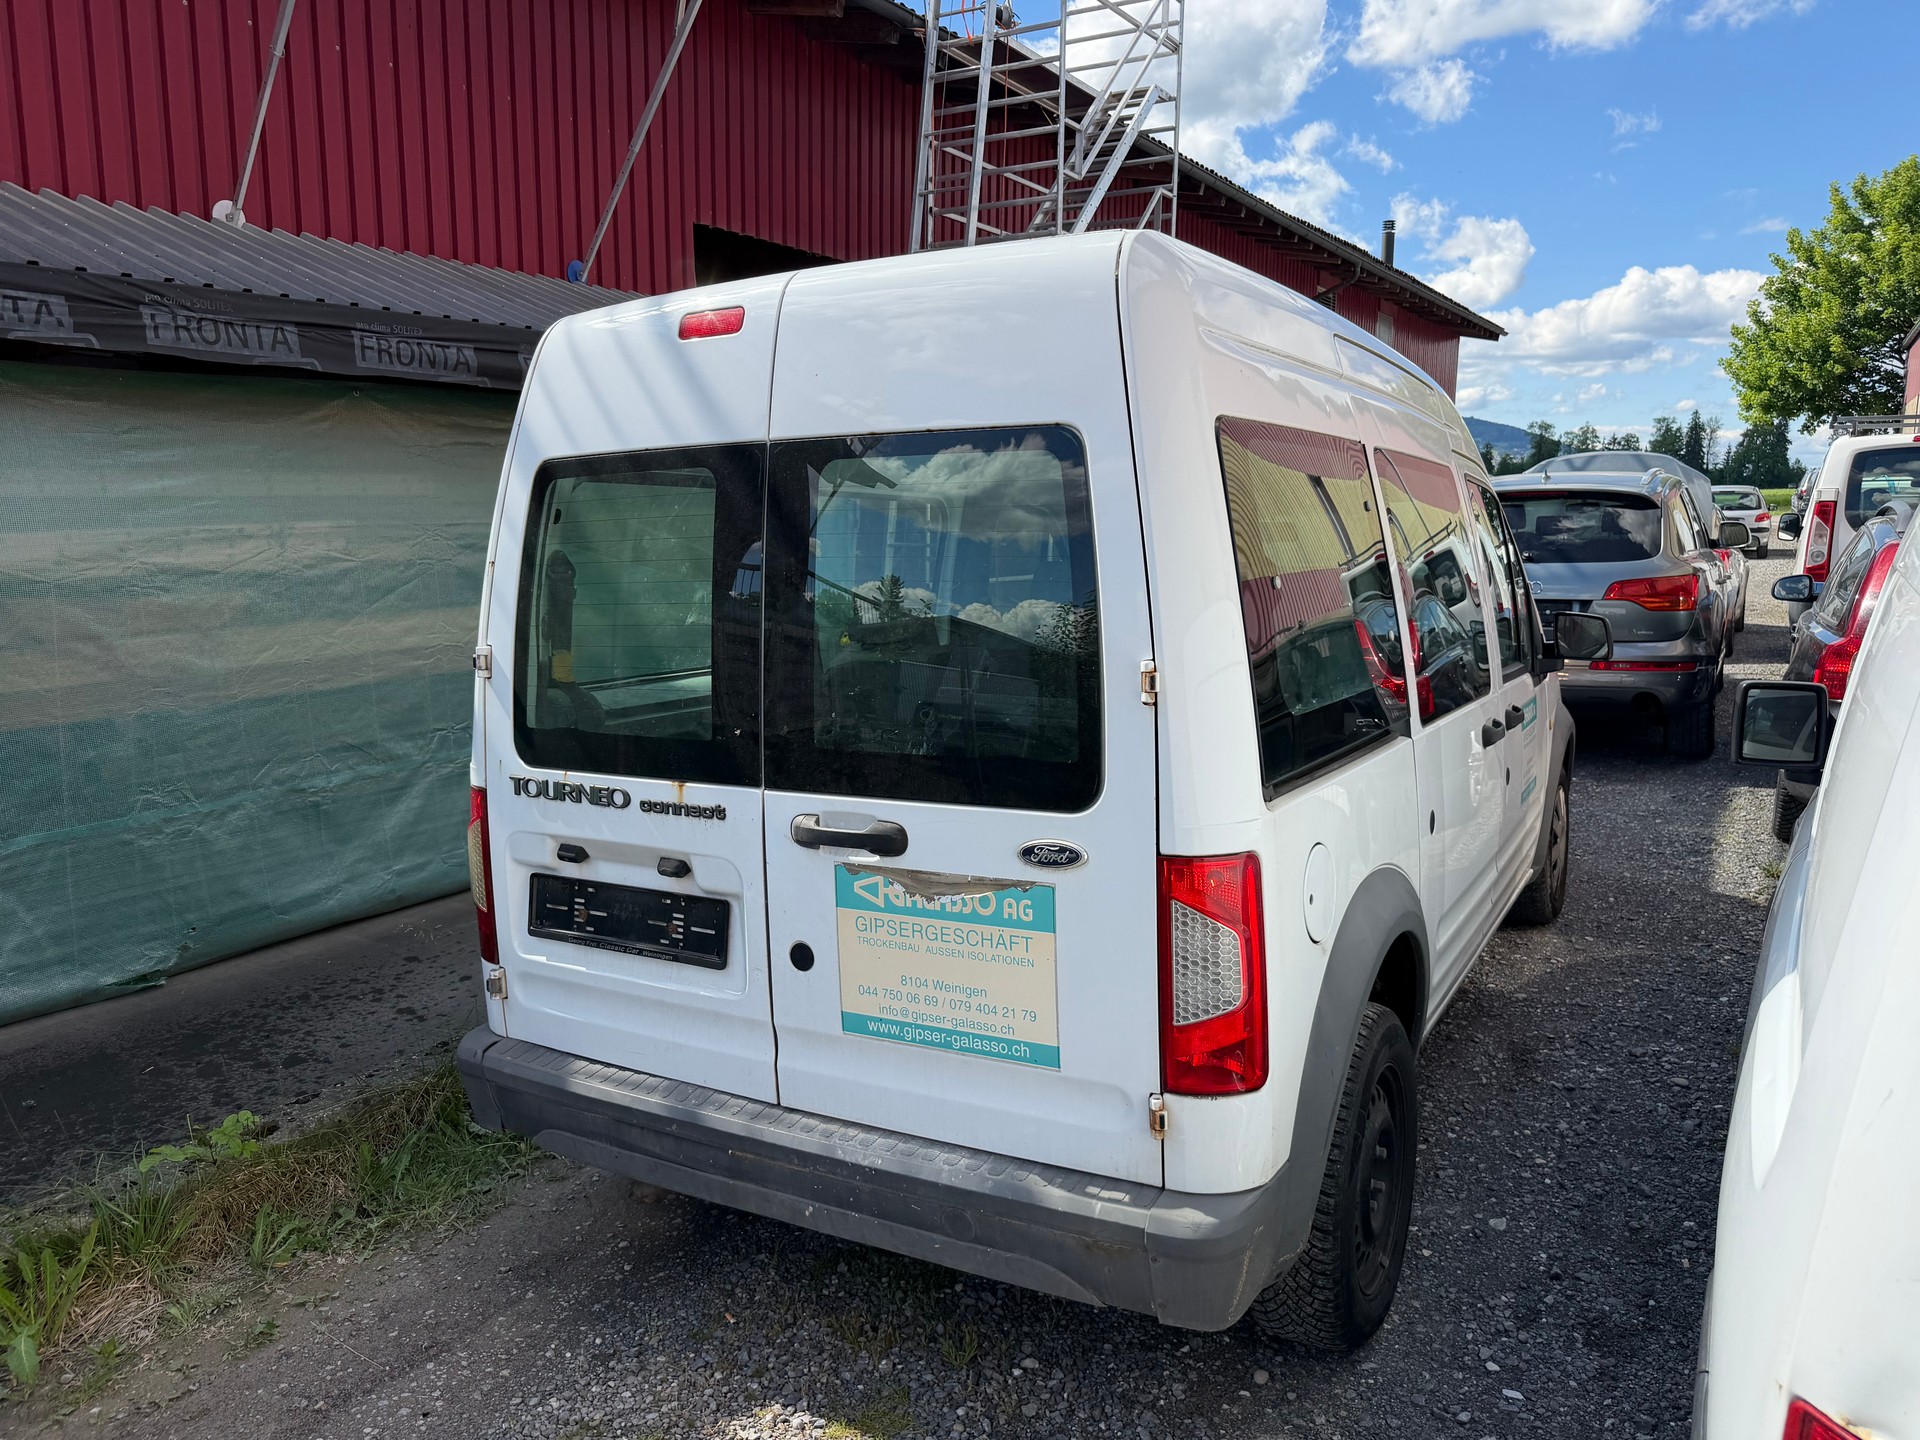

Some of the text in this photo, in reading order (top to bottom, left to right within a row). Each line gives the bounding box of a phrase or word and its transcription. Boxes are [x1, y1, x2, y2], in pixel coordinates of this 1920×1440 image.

[145, 293, 161, 303] pro
[193, 299, 234, 313] SOLITEX
[150, 312, 294, 354] FRONTA
[356, 322, 424, 336] pro clima SOLITEX
[359, 336, 472, 374] FRONTA
[509, 774, 726, 821] TOURNEO connect
[1030, 845, 1070, 864] Ford
[1003, 897, 1034, 922] AG
[599, 941, 626, 952] Classic
[626, 946, 640, 955] Car
[855, 914, 1034, 954] GIPSERGESCHÄFT
[857, 935, 1035, 968] TROCKENBAU AUSSEN ISOLATIONEN
[900, 974, 987, 999] 8104 Weinigen
[858, 984, 879, 998] 044
[882, 988, 903, 1002] 750
[906, 992, 921, 1004] 06
[924, 994, 939, 1007] 69
[949, 998, 971, 1013] 079
[975, 1002, 998, 1017] 404
[1002, 1006, 1016, 1020] 21
[1021, 1009, 1038, 1023] 79
[867, 1020, 1031, 1058] www.gipser-galasso.ch
